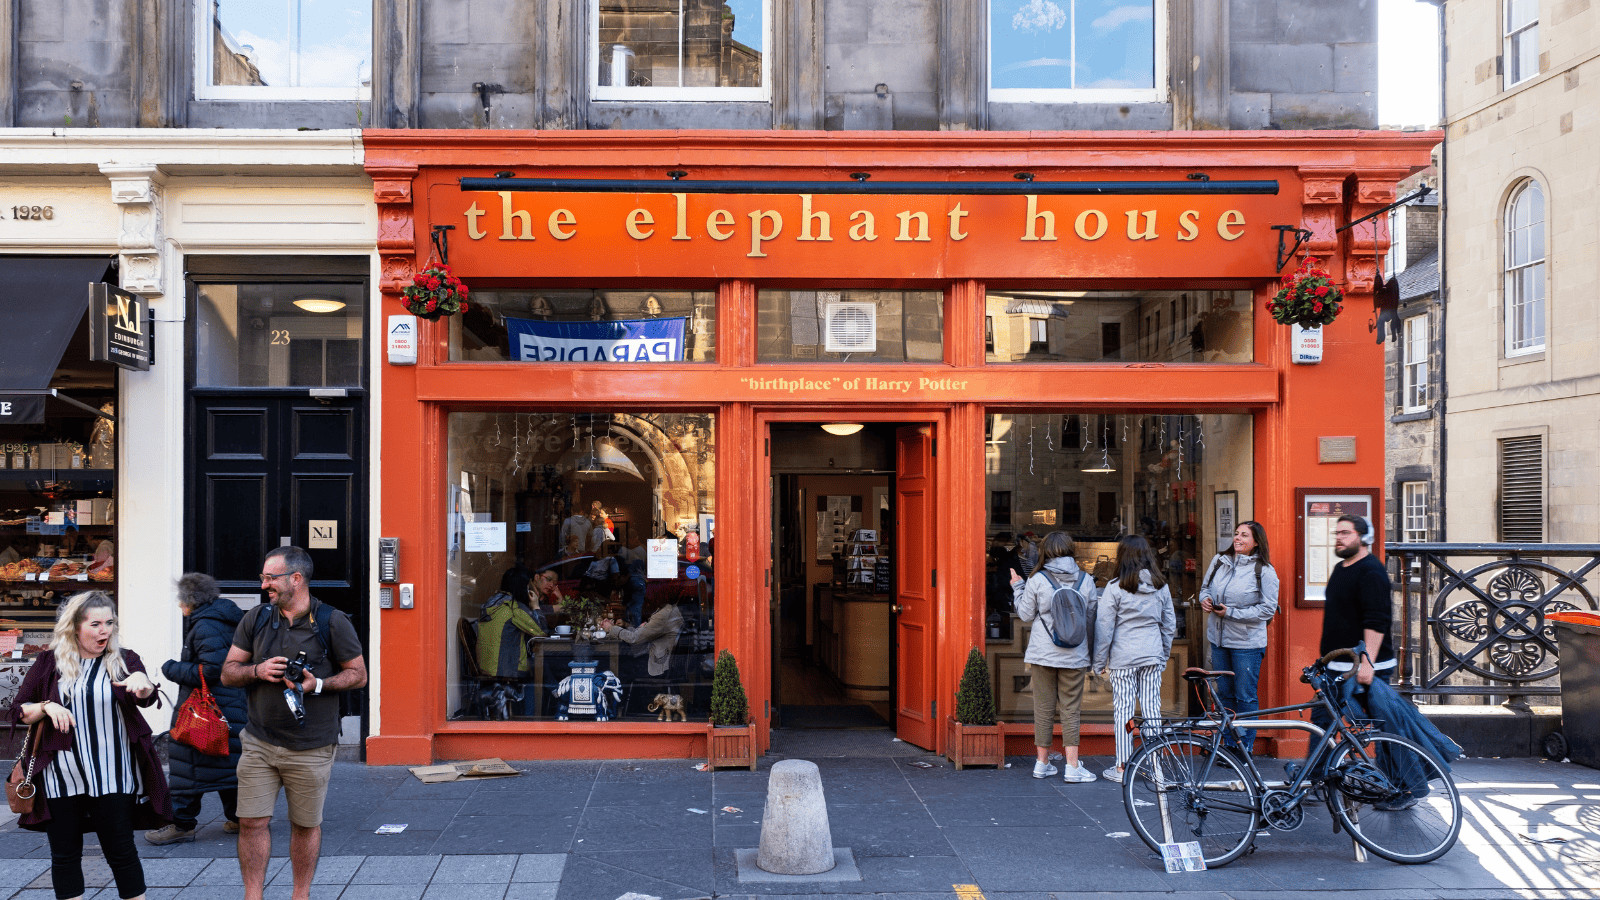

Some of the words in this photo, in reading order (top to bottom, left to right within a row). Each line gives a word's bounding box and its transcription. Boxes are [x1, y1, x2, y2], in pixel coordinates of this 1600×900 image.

[11, 205, 54, 220] 1926
[463, 191, 577, 240] the
[625, 193, 969, 257] elephant
[1020, 194, 1246, 241] house
[114, 332, 144, 347] EDINBURGH
[271, 329, 291, 345] 23
[842, 377, 861, 391] of
[865, 377, 912, 393] Harry
[919, 377, 968, 391] Potter
[511, 434, 562, 453] are
